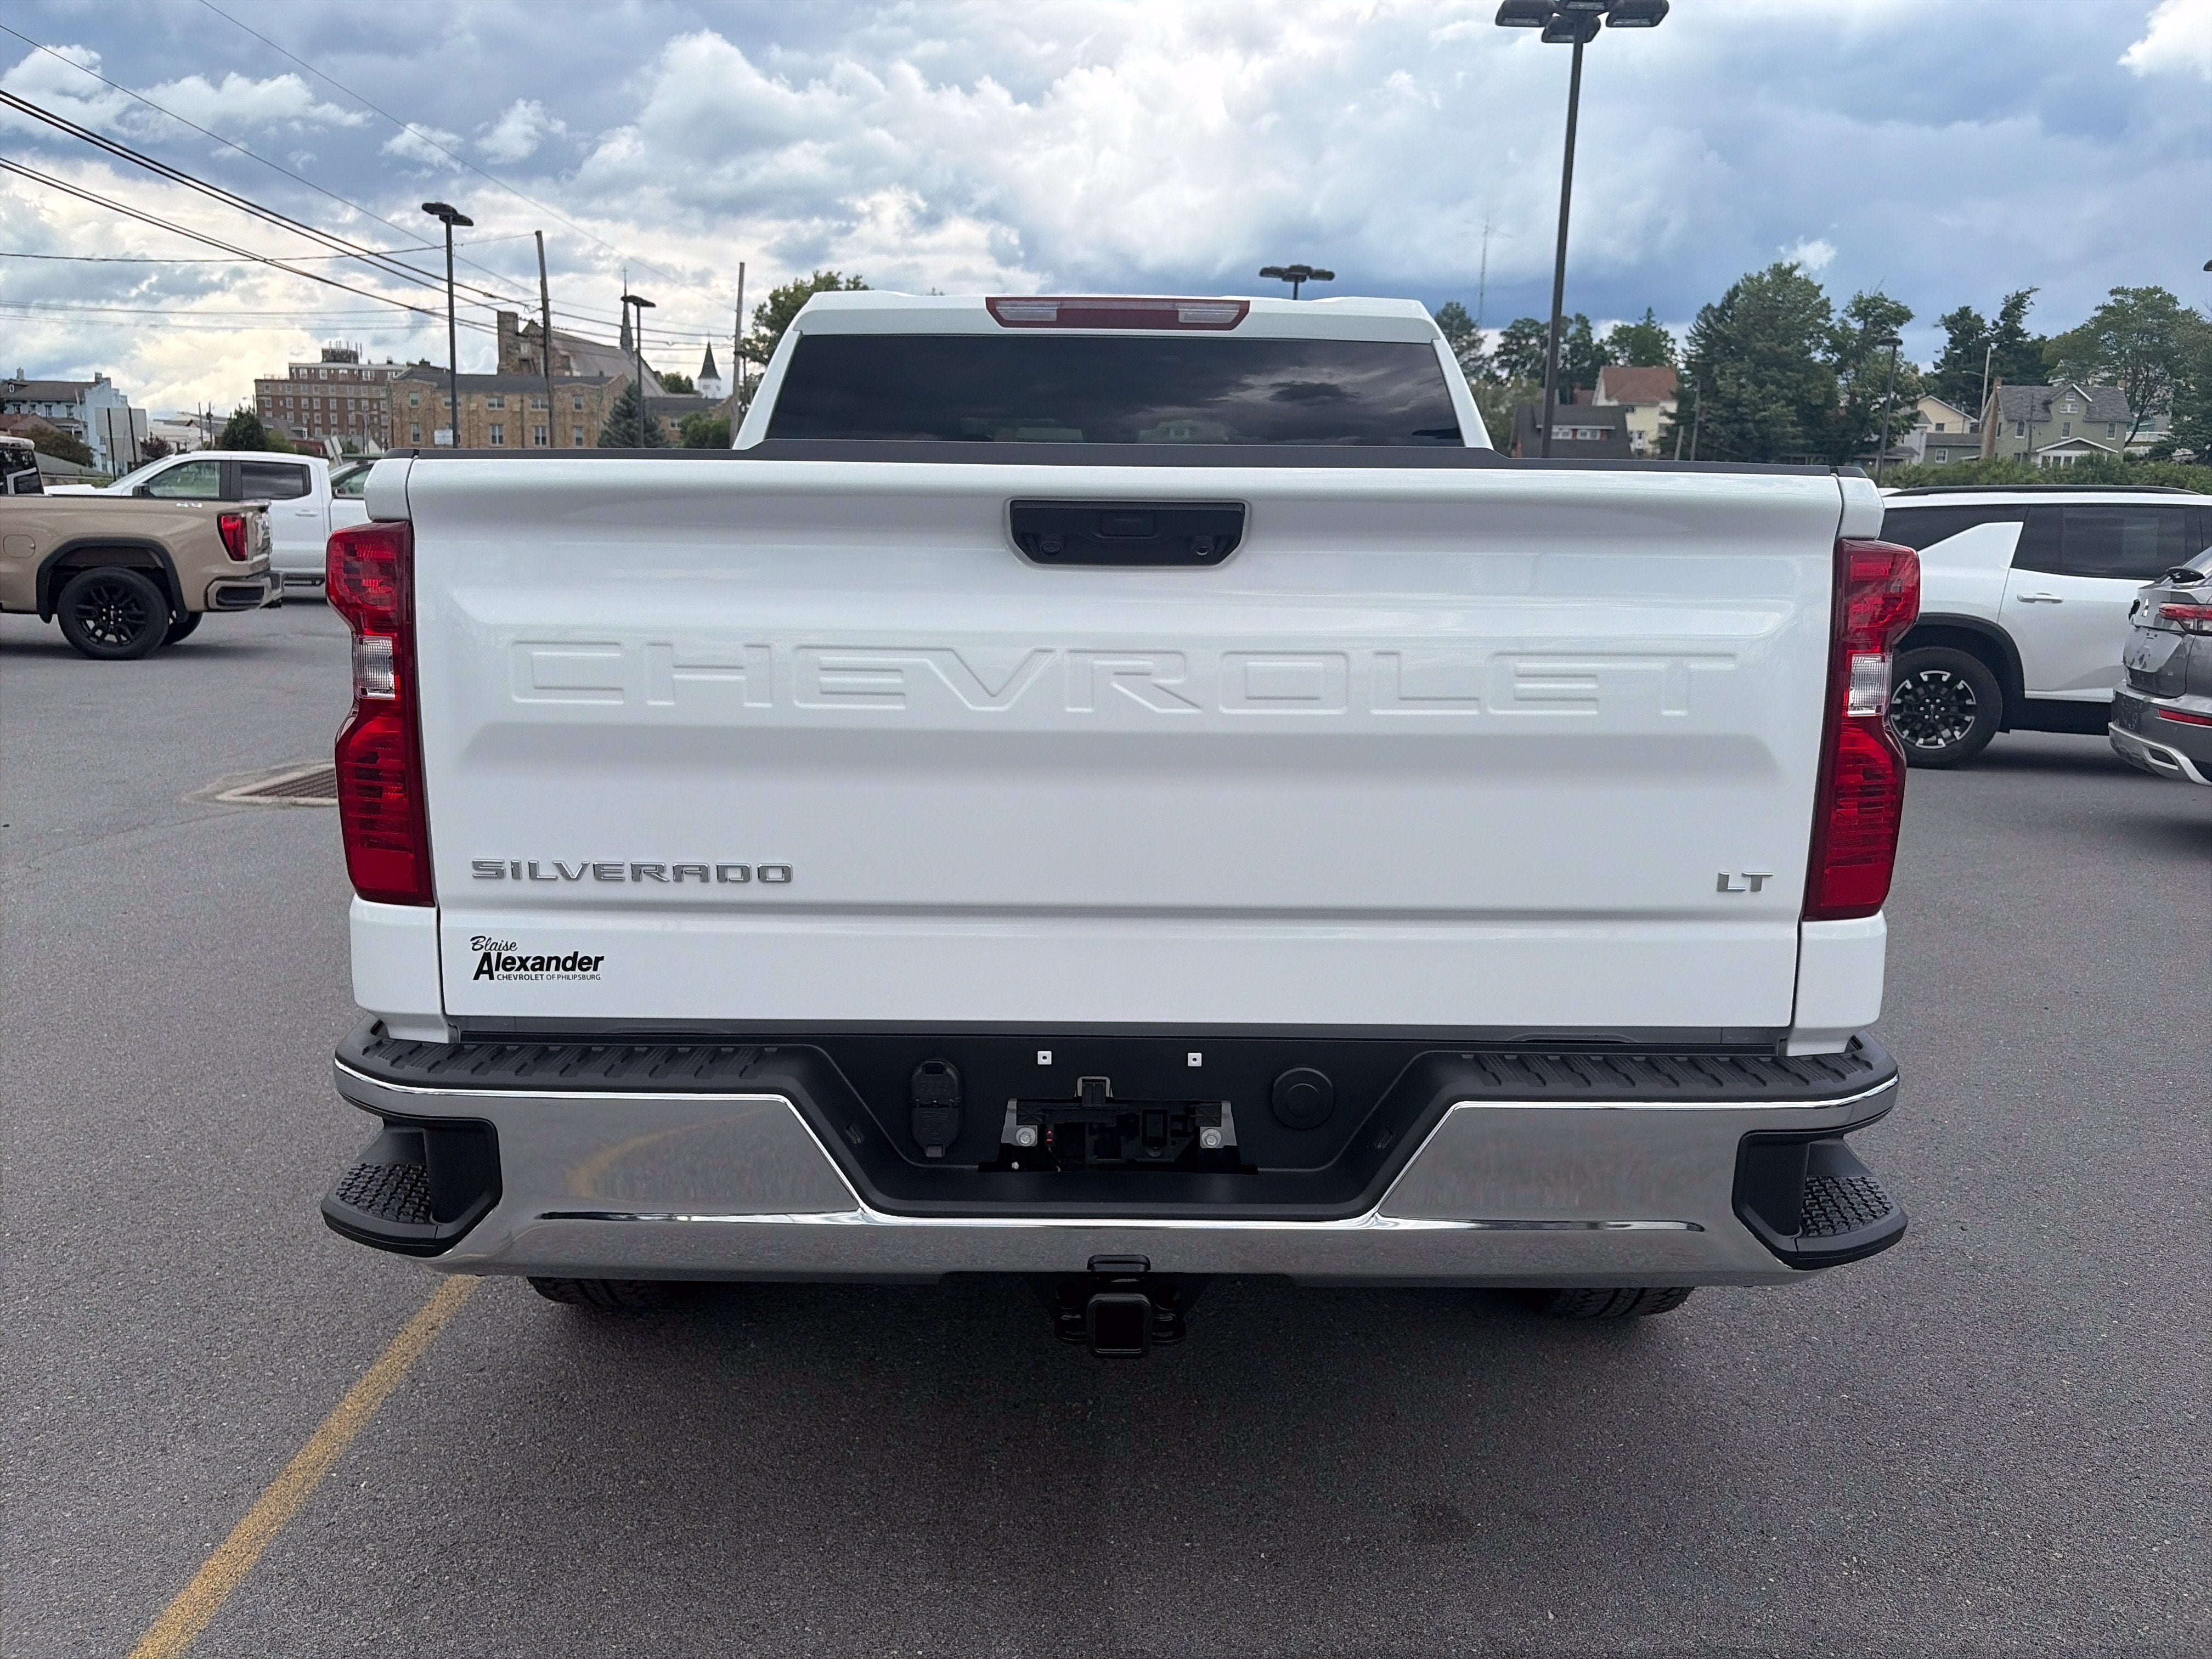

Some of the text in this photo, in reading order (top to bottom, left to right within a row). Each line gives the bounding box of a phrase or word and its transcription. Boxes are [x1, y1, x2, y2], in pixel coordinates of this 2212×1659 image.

[510, 640, 1738, 716] CHEVROLET
[472, 859, 794, 884] SILVERADO
[1716, 871, 1774, 892] LT
[470, 935, 518, 951] Blaise
[472, 951, 605, 981] Alexander
